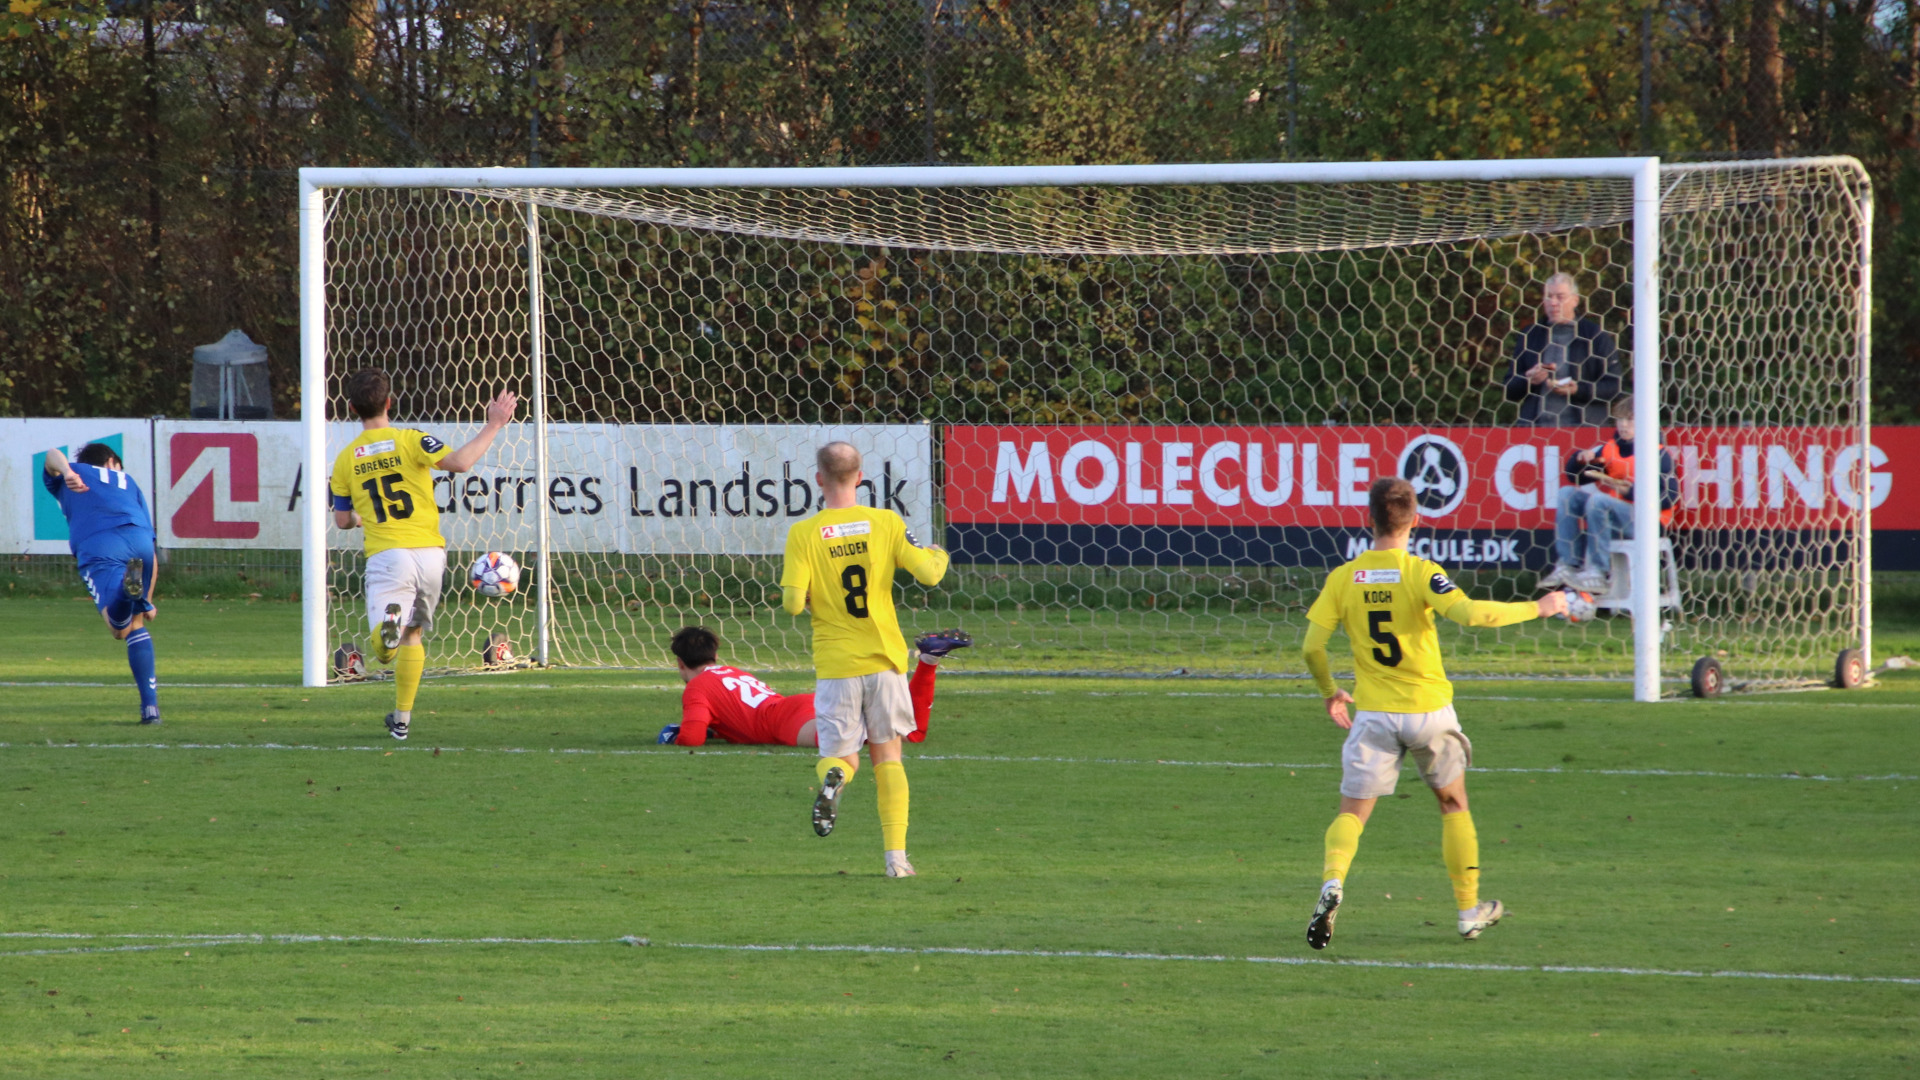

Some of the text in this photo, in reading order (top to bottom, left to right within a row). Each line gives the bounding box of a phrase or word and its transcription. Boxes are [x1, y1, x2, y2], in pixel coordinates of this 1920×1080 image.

[354, 456, 402, 475] SØRENSEN
[630, 460, 911, 517] Landsbnk
[992, 439, 1893, 510] MOLECULE CLHING
[362, 473, 414, 523] 15
[828, 541, 868, 558] HOLDEN
[1346, 537, 1520, 562] MECULE.DK
[841, 564, 869, 619] 8
[1363, 590, 1392, 604] KOCH
[1368, 610, 1403, 667] 5
